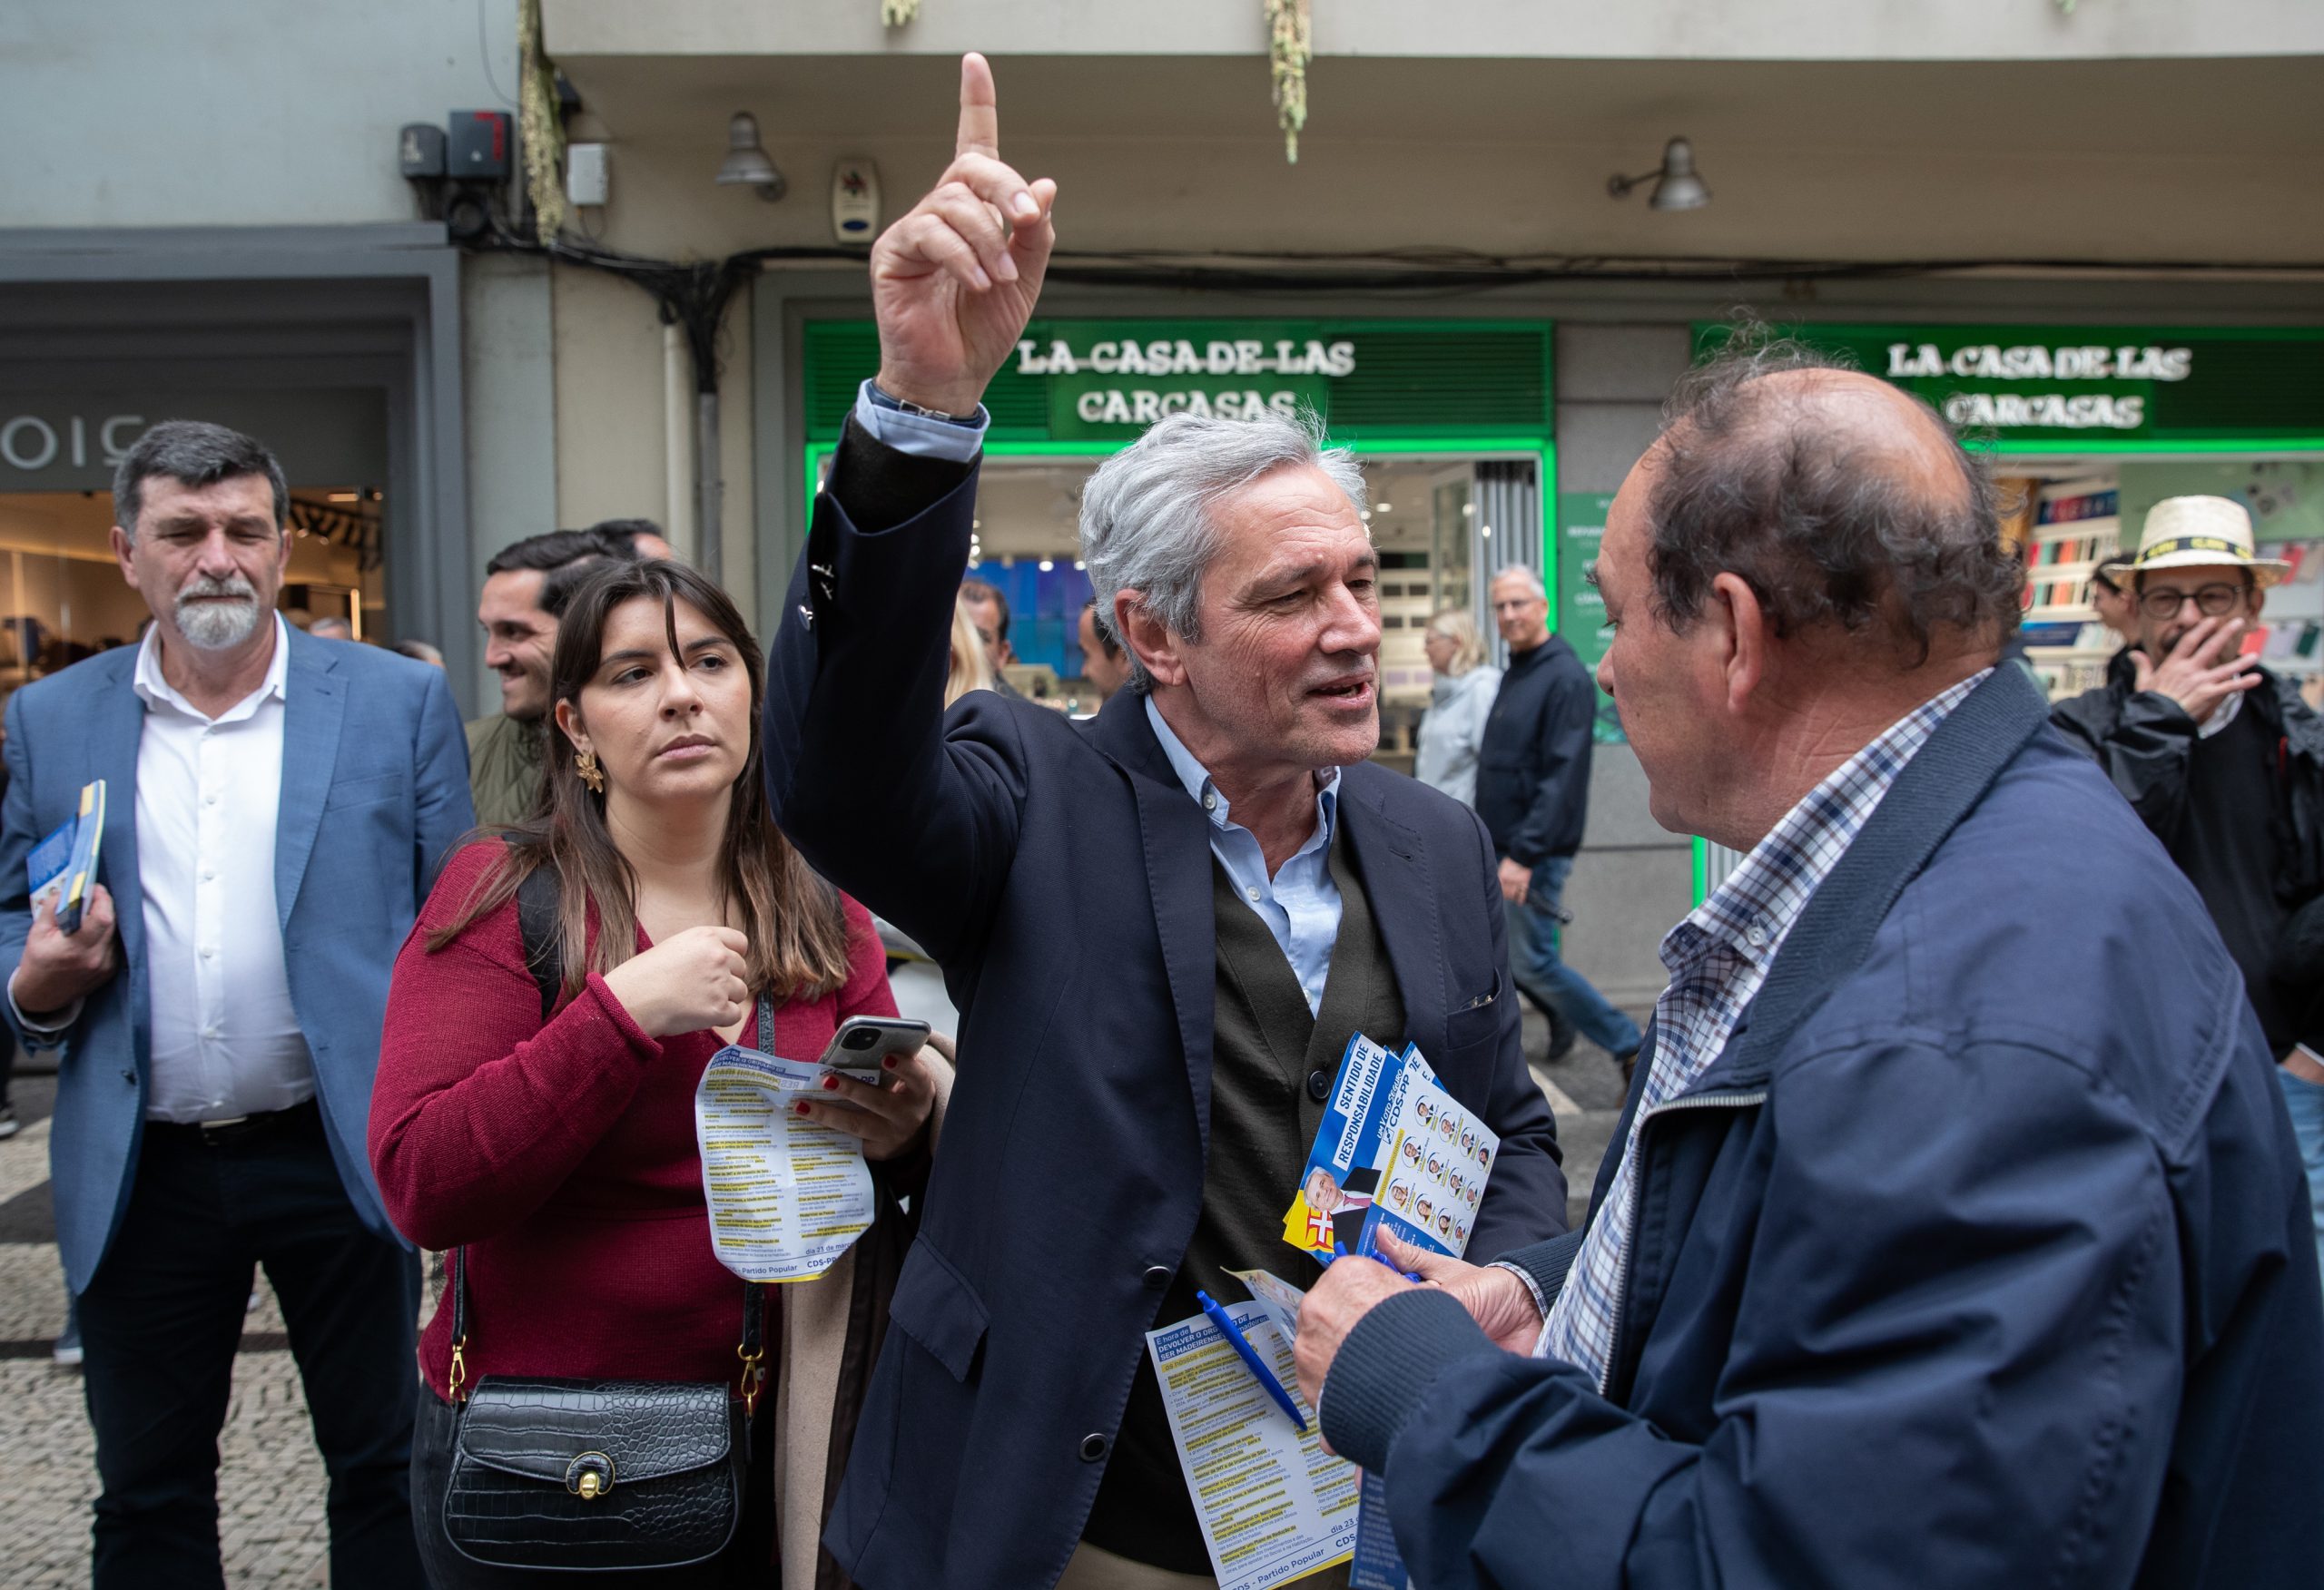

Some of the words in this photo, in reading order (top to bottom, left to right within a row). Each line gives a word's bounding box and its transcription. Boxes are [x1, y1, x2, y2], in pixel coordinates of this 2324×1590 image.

[1017, 340, 1078, 374] LA
[1090, 341, 1201, 376] CASA
[1206, 341, 1264, 375] DE
[1275, 341, 1355, 377] LAS
[1888, 344, 1945, 377] LA
[1952, 345, 2051, 380] CASA
[2055, 346, 2112, 380] DE
[2115, 347, 2191, 382] LAS
[1078, 390, 1296, 424] CARCASAS
[1946, 394, 2144, 428] CARCASAS
[1339, 1060, 1364, 1110] SENTIDO
[1358, 1043, 1369, 1060] DE
[1338, 1053, 1383, 1163] RESPONSABILIDADE
[1388, 1073, 1412, 1127] CDS-PP
[742, 1266, 767, 1274] Partido
[769, 1264, 798, 1275] Popular
[1158, 1333, 1195, 1352] DEVOLVER
[1237, 1314, 1247, 1323] DE
[1162, 1330, 1178, 1342] hora
[1179, 1327, 1189, 1336] de
[1160, 1350, 1175, 1360] SER
[1331, 1524, 1344, 1535] dia
[1344, 1518, 1354, 1529] 23
[1257, 1564, 1290, 1584] Partido
[1291, 1547, 1324, 1568] Popular
